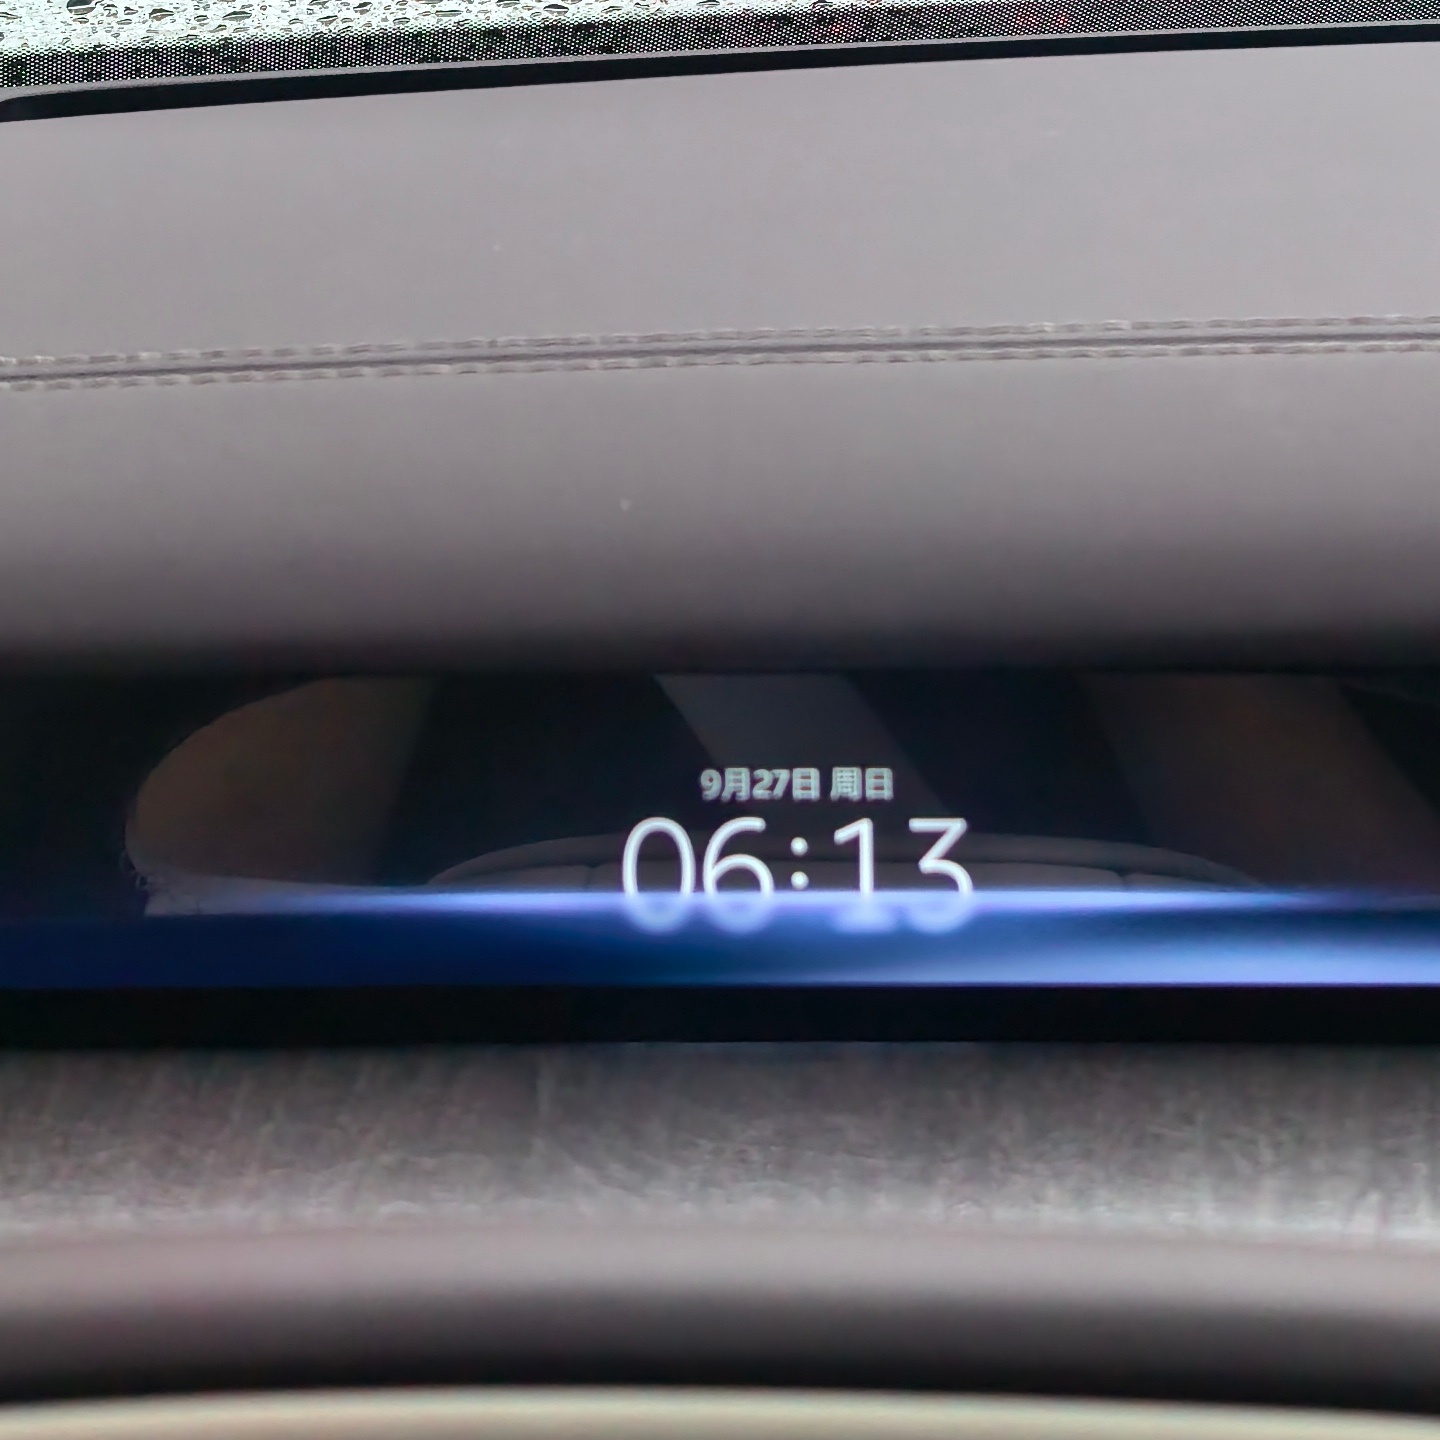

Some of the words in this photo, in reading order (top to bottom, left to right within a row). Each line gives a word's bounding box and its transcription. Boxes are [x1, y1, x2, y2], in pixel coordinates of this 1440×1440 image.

[700, 766, 820, 802] 9月27日
[830, 766, 894, 802] 周日
[621, 816, 975, 934] 06:13
